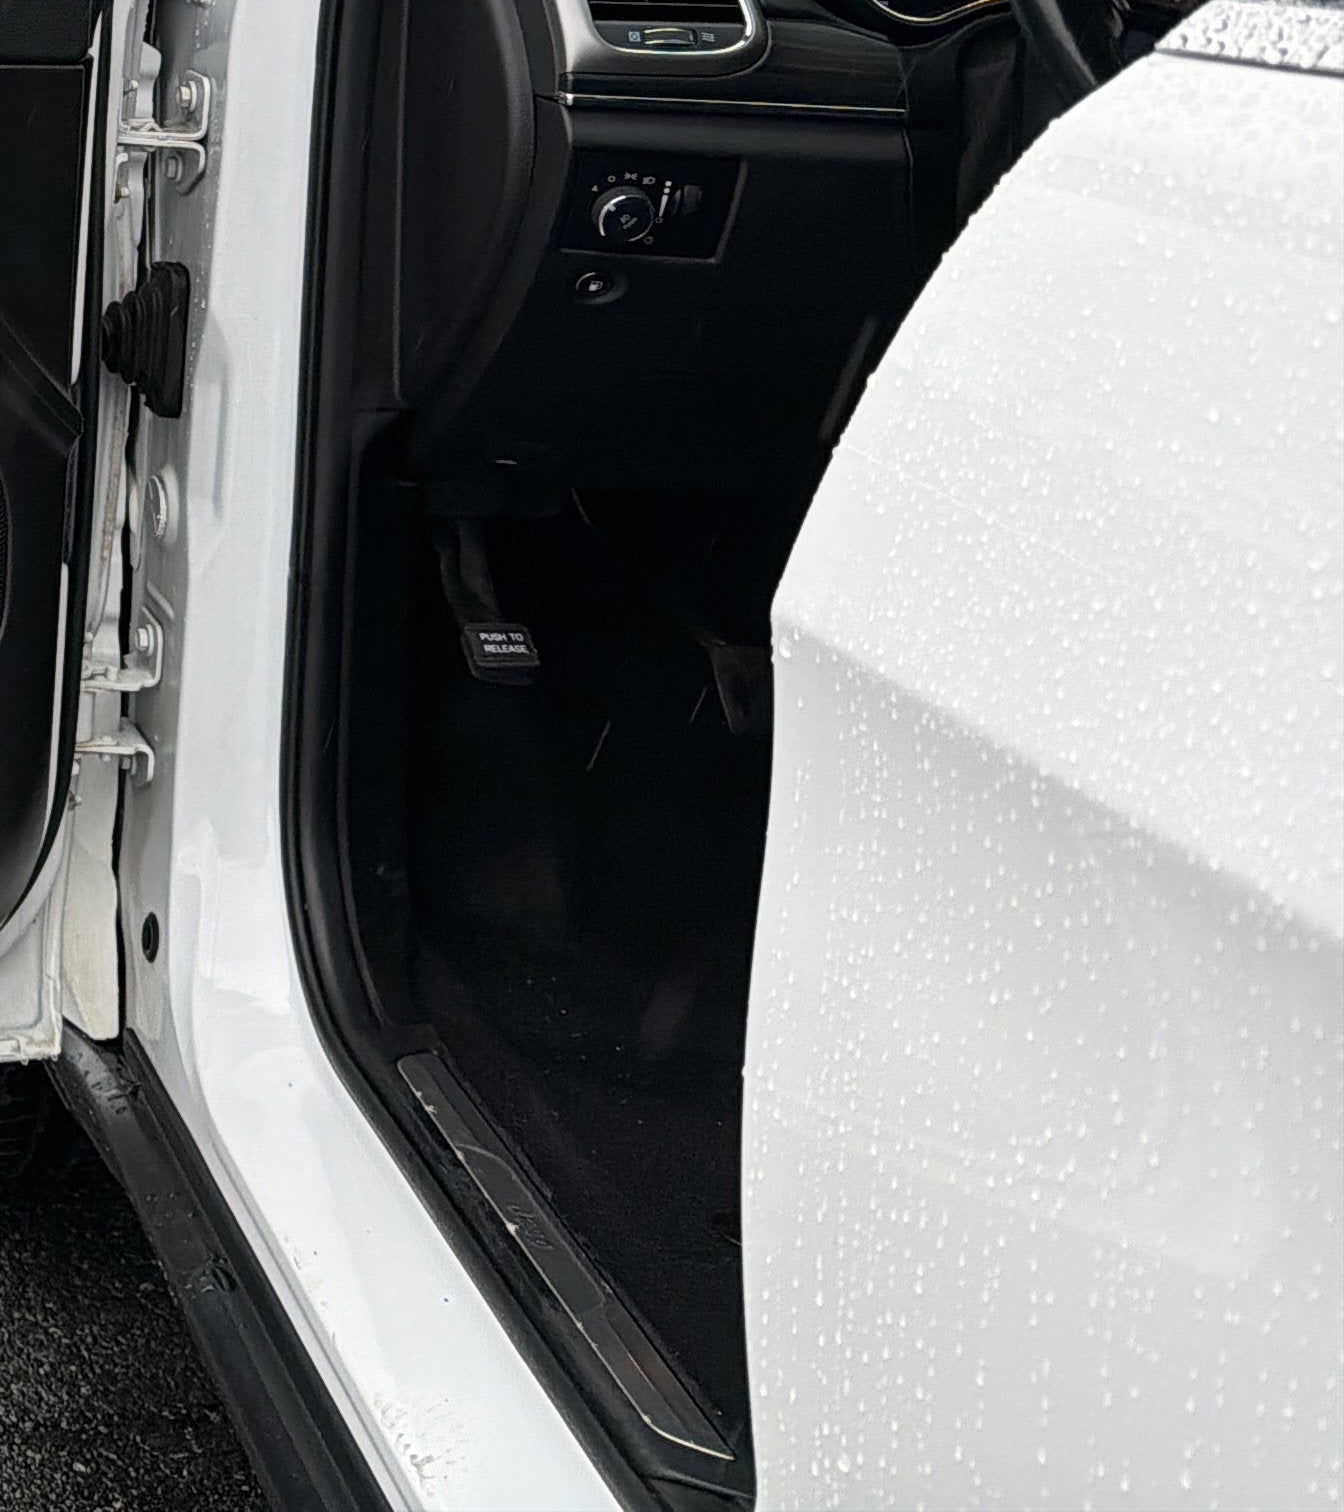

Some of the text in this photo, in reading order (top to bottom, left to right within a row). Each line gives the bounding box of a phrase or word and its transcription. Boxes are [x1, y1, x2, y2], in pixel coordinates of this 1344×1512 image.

[479, 632, 524, 641] PUSH TO
[483, 644, 529, 654] RELEASE
